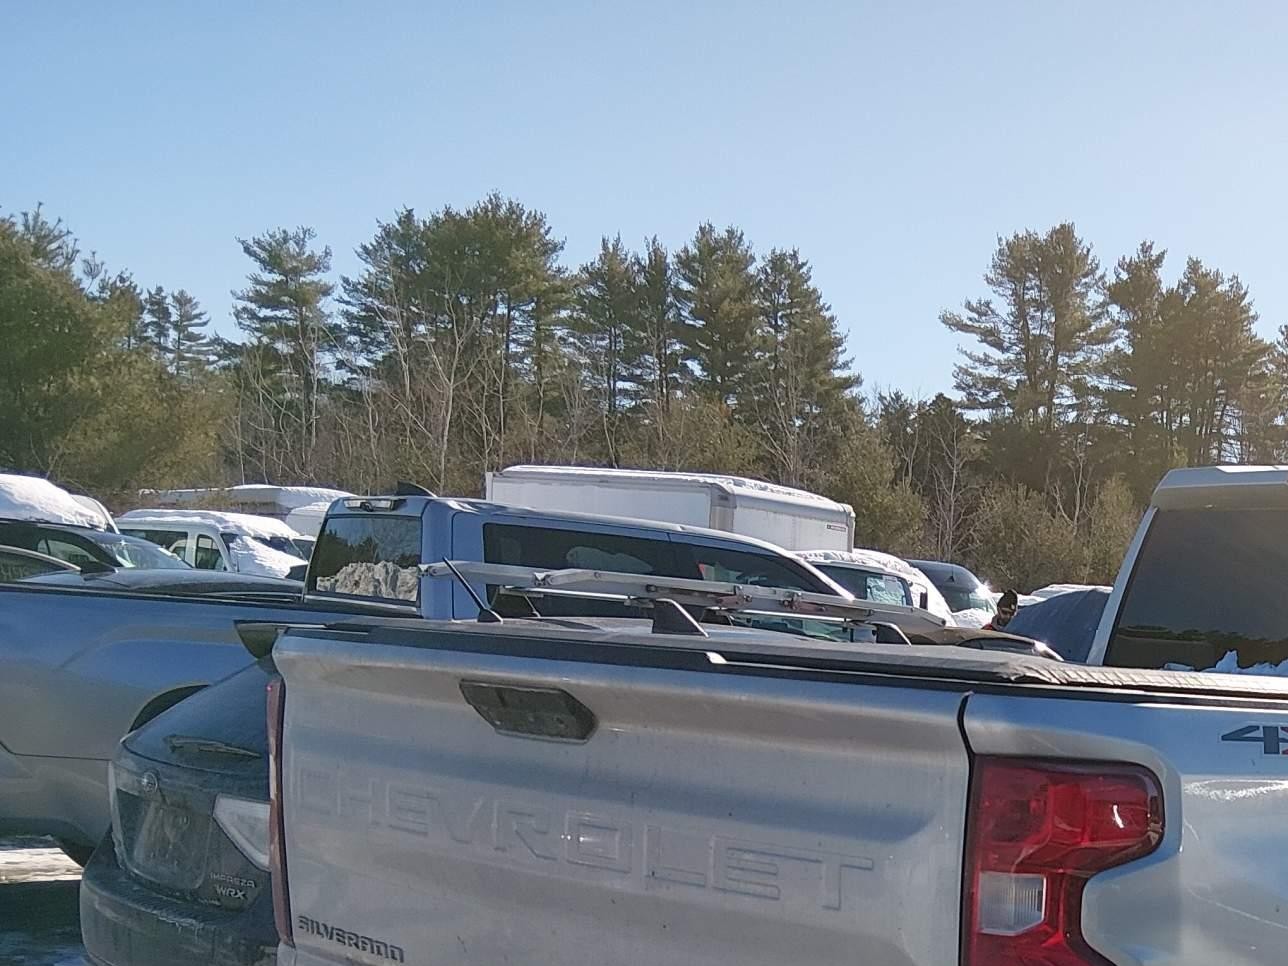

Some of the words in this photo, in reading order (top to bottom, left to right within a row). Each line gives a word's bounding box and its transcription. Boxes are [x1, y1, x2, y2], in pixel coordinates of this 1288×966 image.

[293, 765, 875, 911] CHEVROLET
[214, 884, 247, 901] WRX
[298, 914, 405, 964] SILVERADO
